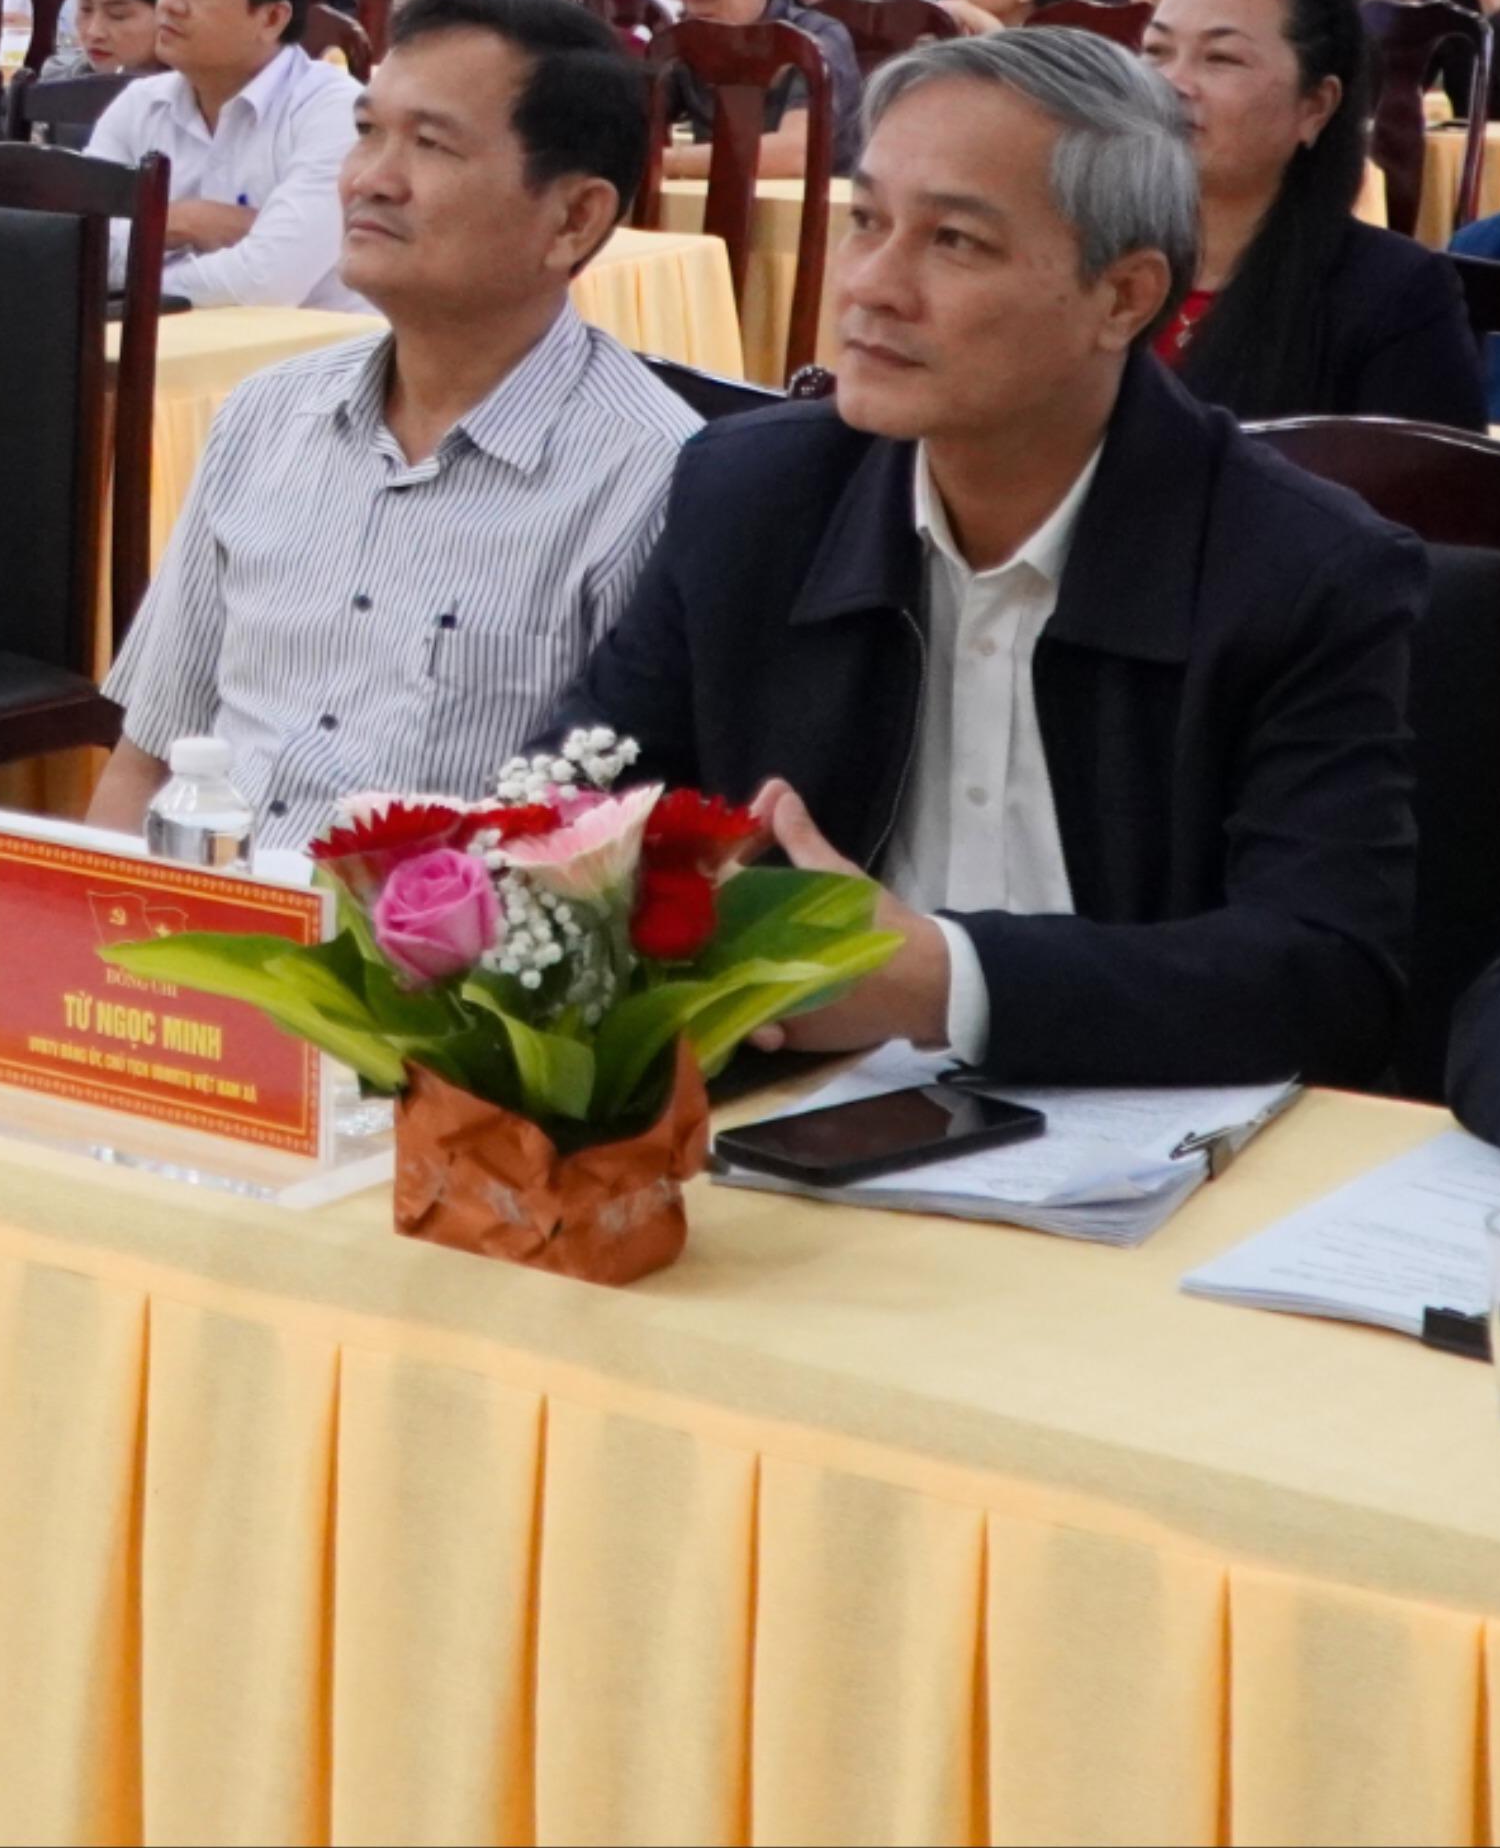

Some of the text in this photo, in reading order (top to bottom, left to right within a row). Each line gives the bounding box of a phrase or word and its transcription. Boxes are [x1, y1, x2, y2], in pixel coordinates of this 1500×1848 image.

[62, 989, 223, 1061] TỪ NGỌC MINH
